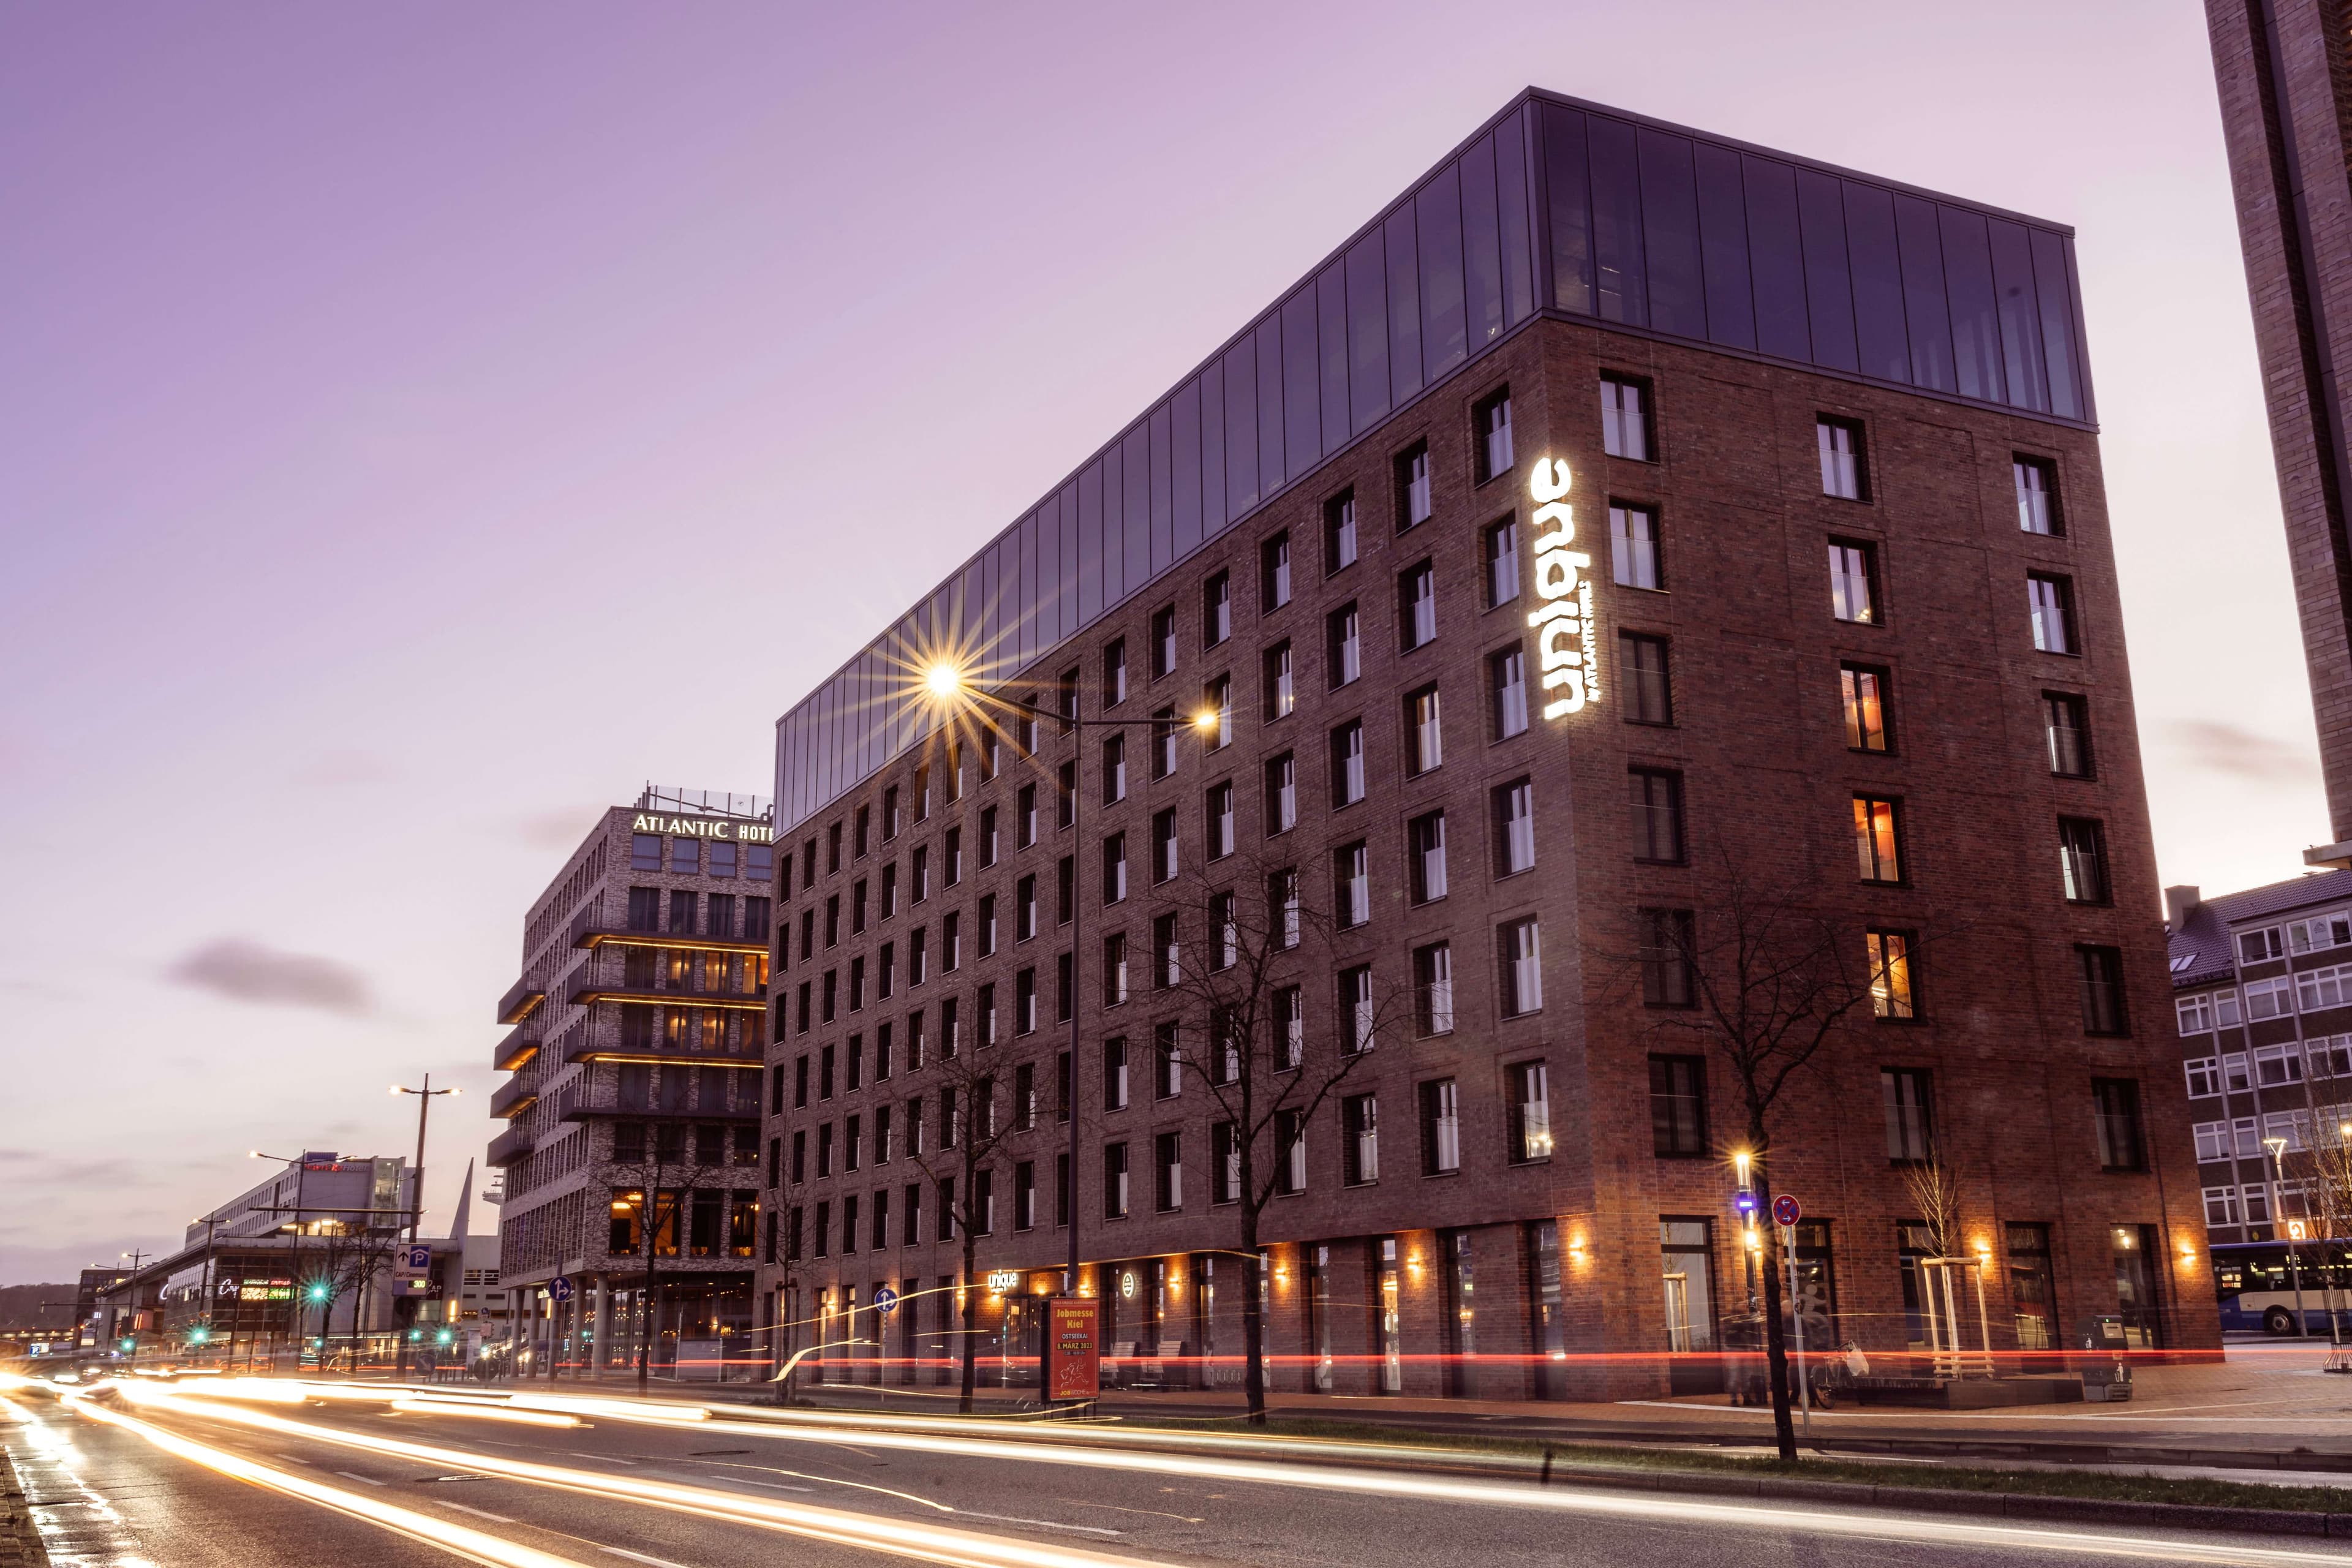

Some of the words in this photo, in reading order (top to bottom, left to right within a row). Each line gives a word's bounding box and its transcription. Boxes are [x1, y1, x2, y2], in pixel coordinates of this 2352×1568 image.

[1528, 456, 1591, 720] unique
[1580, 617, 1598, 688] ATLANTIC
[633, 814, 728, 838] ATLANTIC
[415, 1253, 424, 1265] P
[413, 1280, 426, 1288] 300
[988, 1269, 1019, 1292] unique
[1057, 1308, 1094, 1317] Jobmesse
[1066, 1319, 1084, 1329] Kiel
